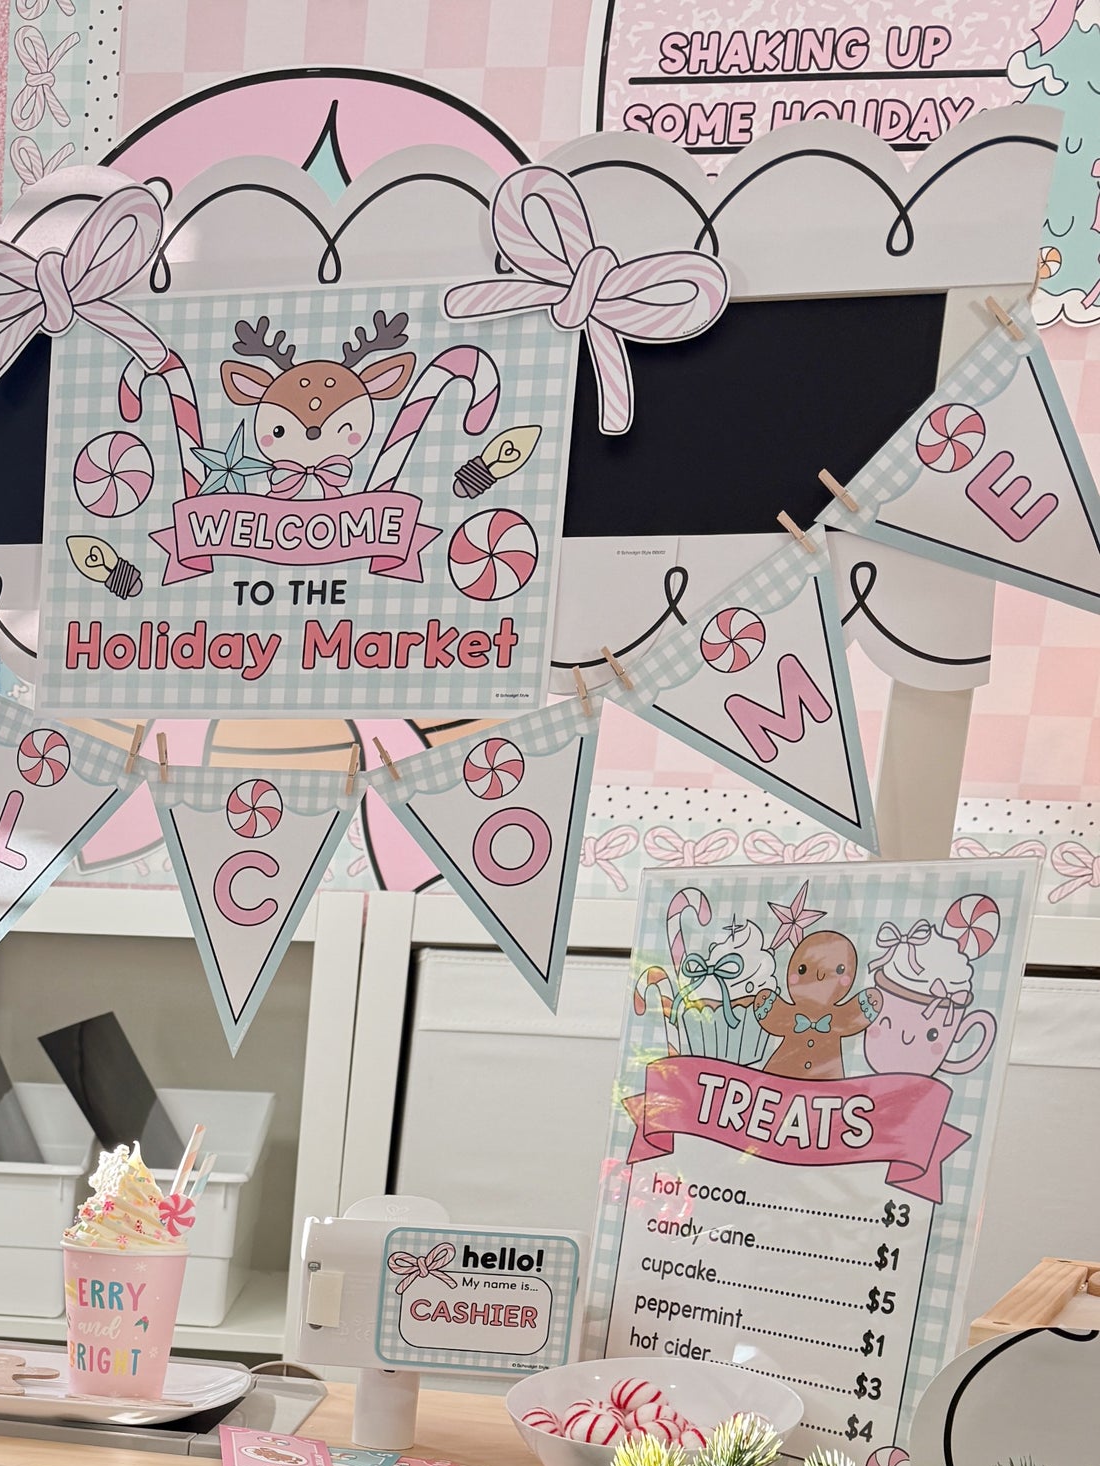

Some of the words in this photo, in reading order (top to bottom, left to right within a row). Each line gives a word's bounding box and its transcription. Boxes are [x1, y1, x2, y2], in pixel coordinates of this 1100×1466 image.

[659, 27, 869, 74] SHAKING
[886, 25, 951, 70] UP
[623, 101, 755, 144] SOME
[189, 507, 403, 550] WELCOME
[233, 581, 274, 606] TO
[289, 580, 346, 605] THE
[66, 621, 281, 681] Holiday
[302, 618, 518, 670] Market
[698, 1072, 875, 1149] TREATS
[652, 1173, 682, 1196] hot
[882, 1199, 911, 1228] $3
[462, 1245, 544, 1273] hello!
[647, 1217, 703, 1245] candy
[874, 1243, 900, 1271] $1
[462, 1277, 480, 1290] My
[483, 1281, 517, 1291] name
[866, 1286, 896, 1315] $5
[78, 1315, 122, 1340] and
[410, 1299, 538, 1329] CASHIER
[69, 1341, 141, 1376] BRIGHT
[860, 1329, 885, 1357] $1
[630, 1326, 659, 1350] hot
[854, 1372, 882, 1400] $3
[845, 1414, 873, 1443] $4
